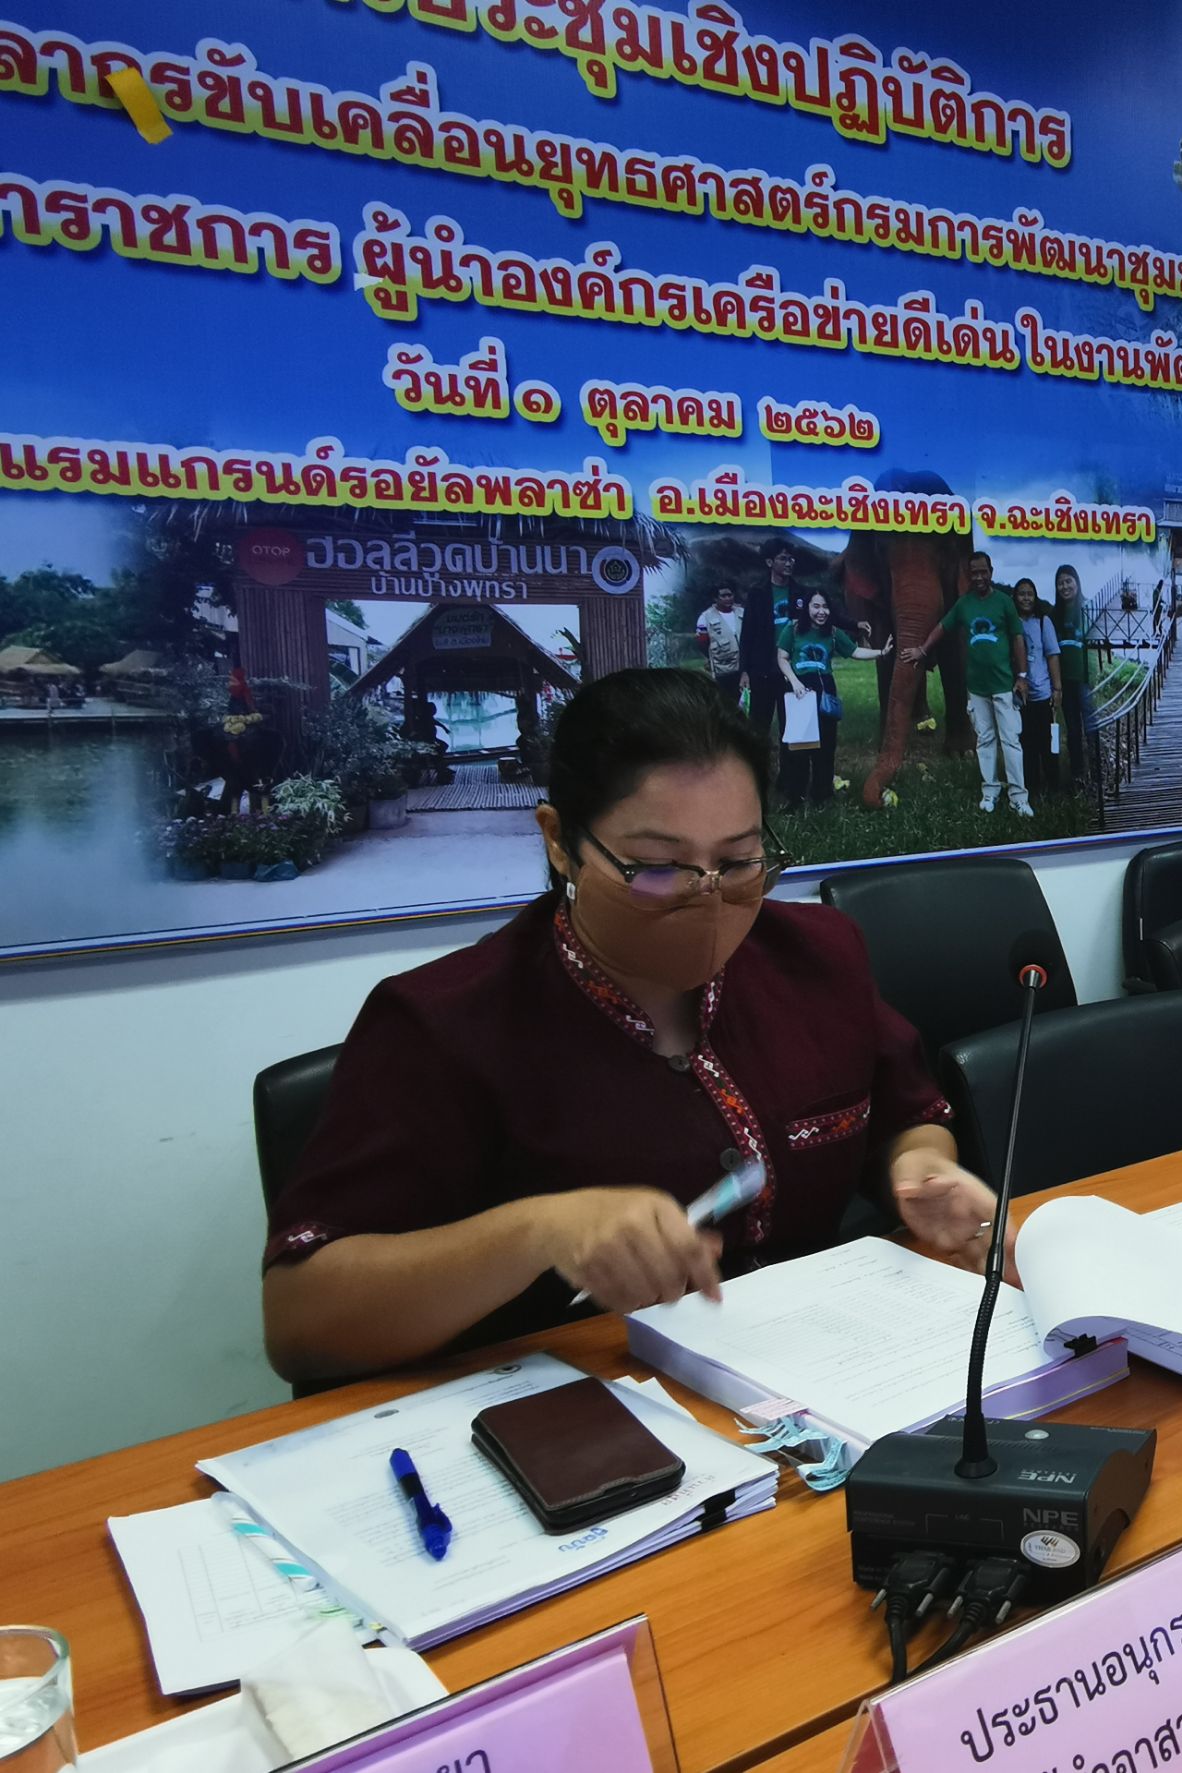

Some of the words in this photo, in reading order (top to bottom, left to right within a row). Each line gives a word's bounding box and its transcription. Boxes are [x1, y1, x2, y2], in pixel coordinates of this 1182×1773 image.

[392, 345, 501, 410] วันที่
[521, 388, 553, 414] ๑
[588, 384, 737, 438] ตุลาคม
[764, 404, 875, 441] ๒๕๖๒
[252, 544, 290, 557] OTOP
[1022, 1507, 1080, 1527] NPE
